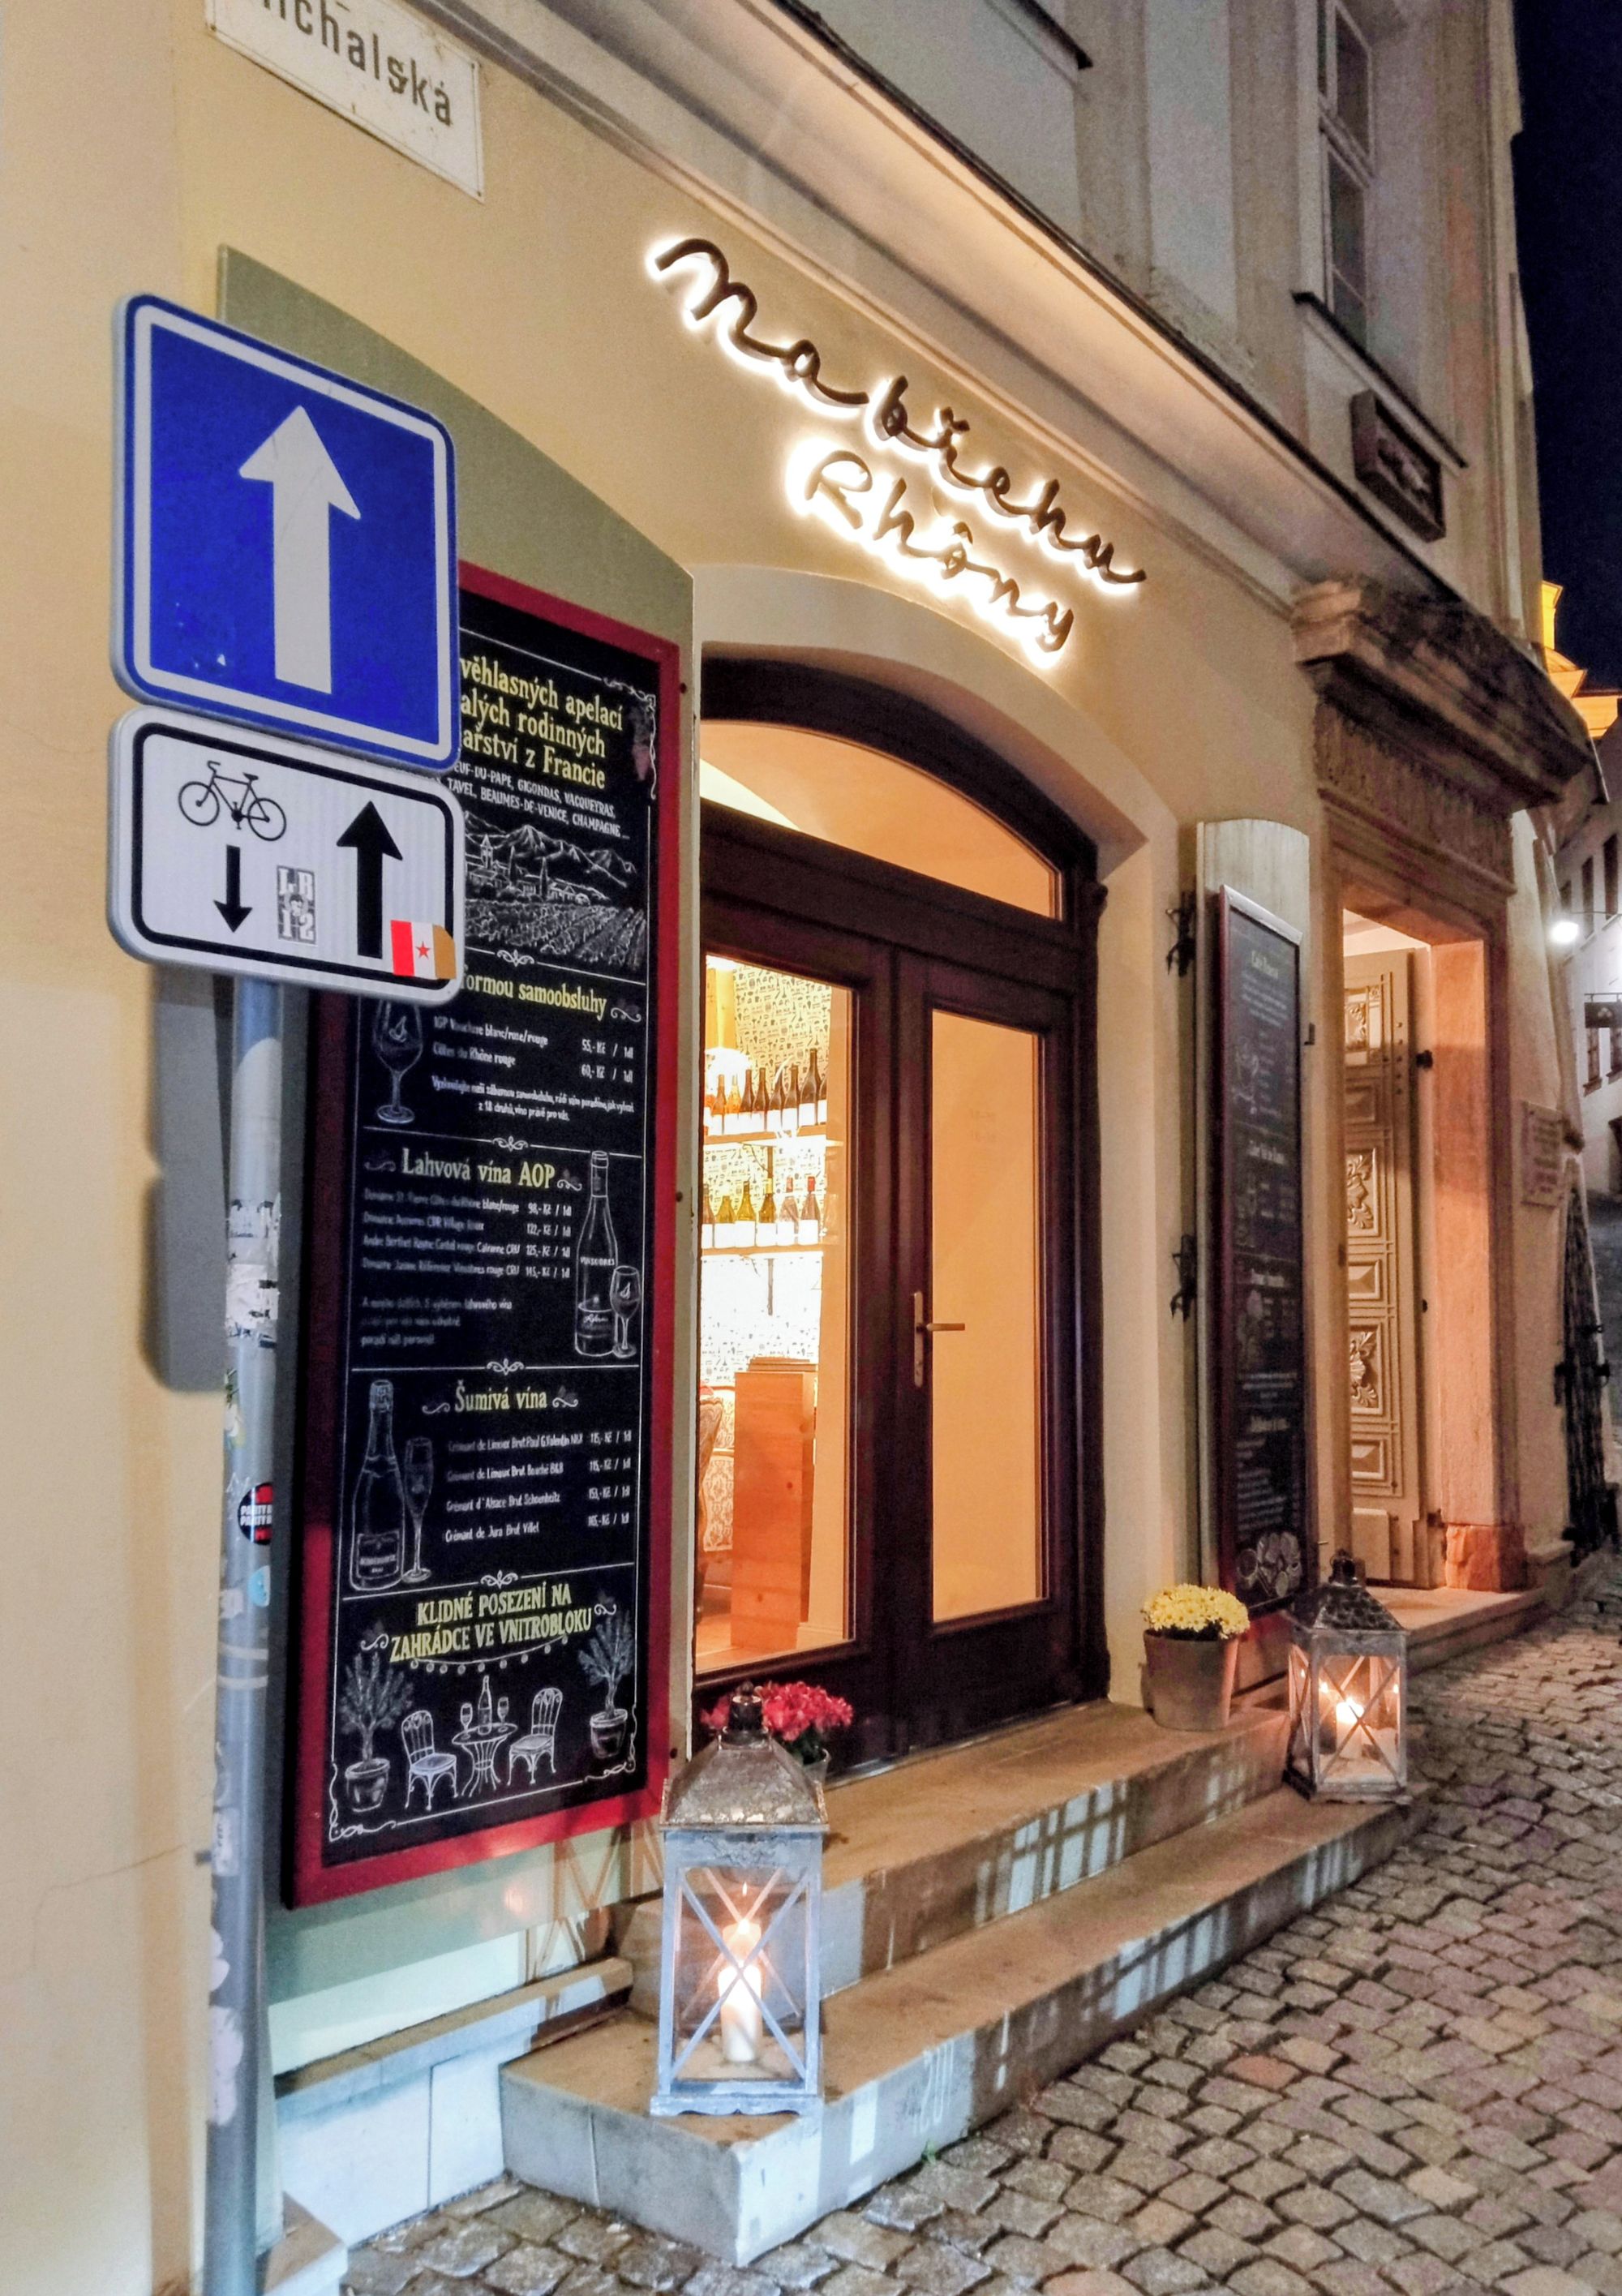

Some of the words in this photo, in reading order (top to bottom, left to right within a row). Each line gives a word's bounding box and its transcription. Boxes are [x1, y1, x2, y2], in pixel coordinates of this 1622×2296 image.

[264, 0, 453, 126] chalská
[804, 450, 1075, 652] Rhôny
[460, 655, 559, 710] věhlasných
[565, 693, 623, 732] apelací
[461, 687, 510, 732] alých
[517, 710, 606, 758] rodinných
[454, 762, 515, 791] EUF-DU-PAPE,
[517, 779, 562, 805] GIGONDAS,
[463, 722, 518, 764] ařství
[525, 747, 536, 769] z
[543, 744, 605, 789] Francie
[517, 982, 607, 1021] samoobsluhy
[402, 1148, 471, 1181] Lahvová
[478, 1160, 512, 1184] vína
[517, 1161, 556, 1190] AOP
[454, 1379, 510, 1413] Šumivá
[516, 1385, 547, 1410] vína
[418, 1591, 474, 1625] KLIDNÉ
[478, 1582, 547, 1617] POSEZENÍ
[551, 1583, 573, 1607] NA
[389, 1624, 471, 1663] ZAHRÁDCE
[475, 1622, 495, 1649] VE
[498, 1607, 593, 1645] VNITROBLOKU
